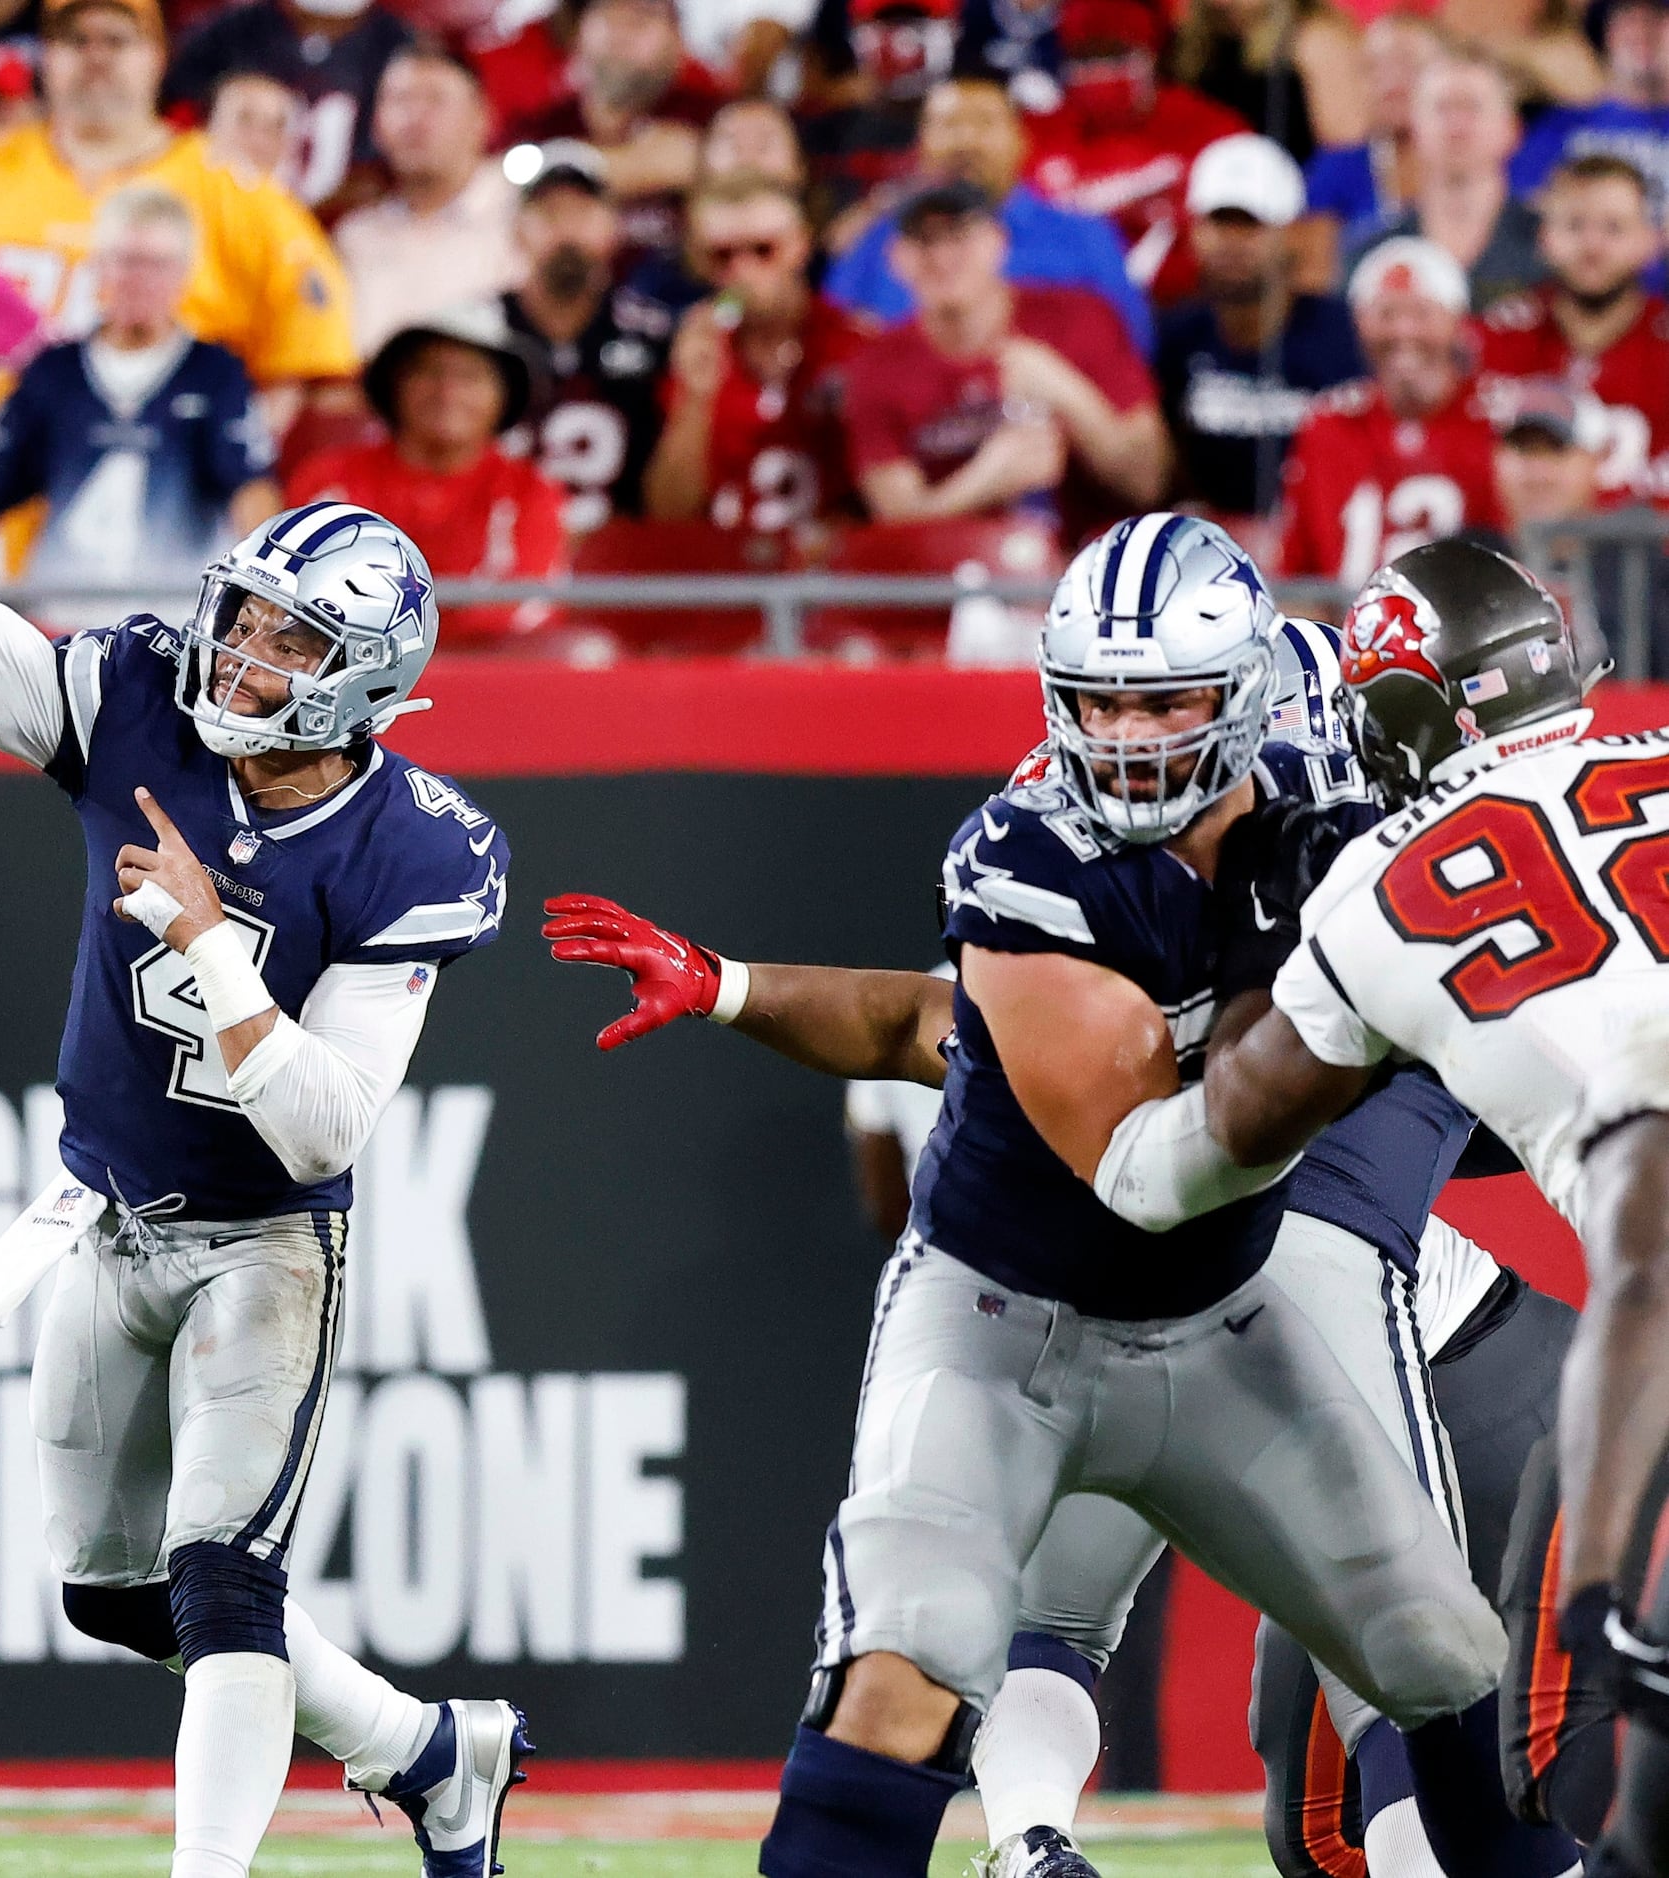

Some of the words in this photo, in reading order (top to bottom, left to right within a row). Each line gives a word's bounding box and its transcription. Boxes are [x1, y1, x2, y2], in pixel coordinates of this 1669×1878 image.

[246, 563, 282, 586] COWBOYS
[404, 767, 489, 830] 4
[1374, 755, 1669, 1024] 92
